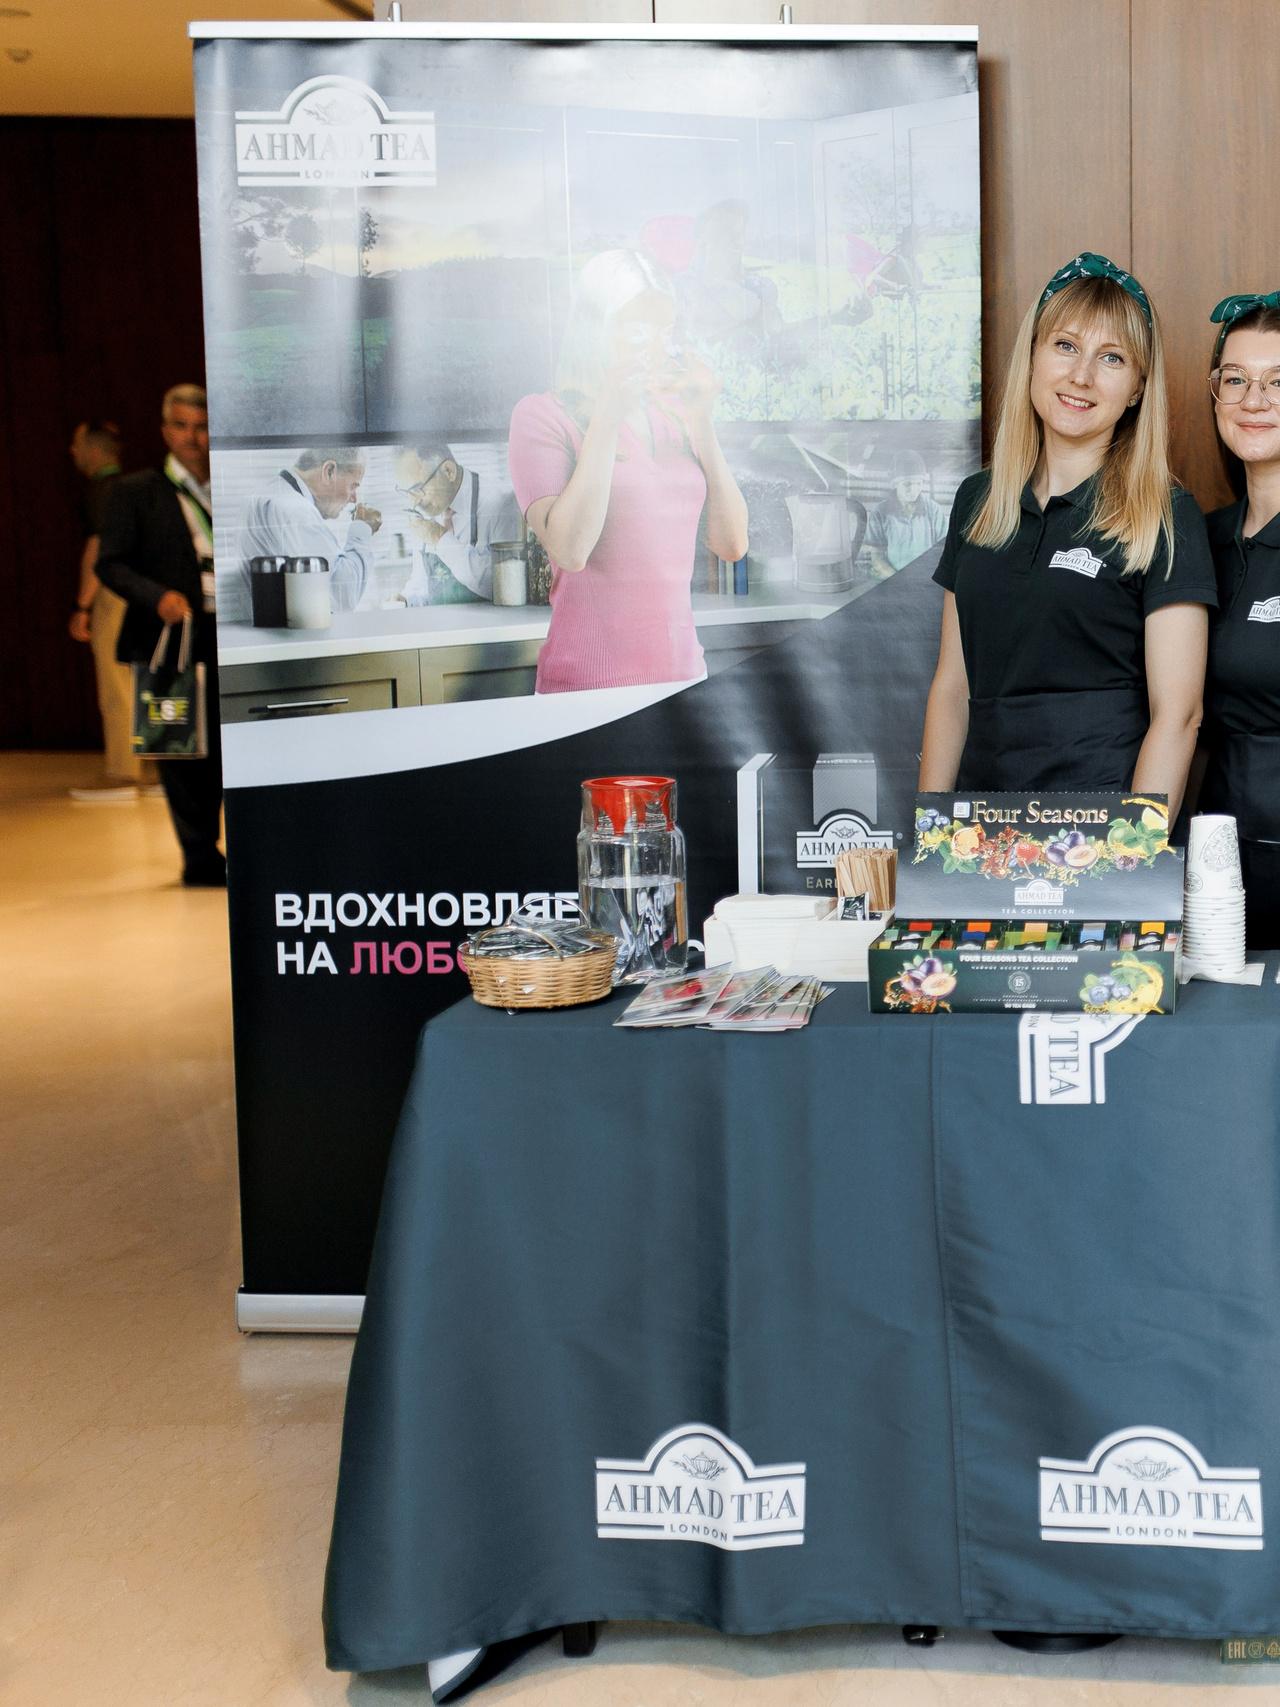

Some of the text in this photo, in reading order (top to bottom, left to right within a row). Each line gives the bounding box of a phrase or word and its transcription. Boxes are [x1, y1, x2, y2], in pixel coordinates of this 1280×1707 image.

[243, 133, 431, 161] AHMAD TEA
[305, 169, 369, 179] LONDON
[1052, 555, 1098, 572] AHMAD TEA
[970, 800, 1109, 824] Four Seasons
[1016, 892, 1062, 900] AHMAD TEA
[274, 892, 580, 934] ВДОХНОВЛЯЕ
[276, 941, 470, 975] НА ЛЮБ
[959, 955, 1079, 963] FOUR SEASONS TEA COLLECTION
[1015, 978, 1025, 987] 15
[1048, 1030, 1080, 1098] TEA
[603, 1483, 799, 1524] AHMAD TEA
[1046, 1482, 1255, 1524] AHMAD TEA
[669, 1523, 729, 1542] LONDON
[1115, 1526, 1188, 1539] LONDON
